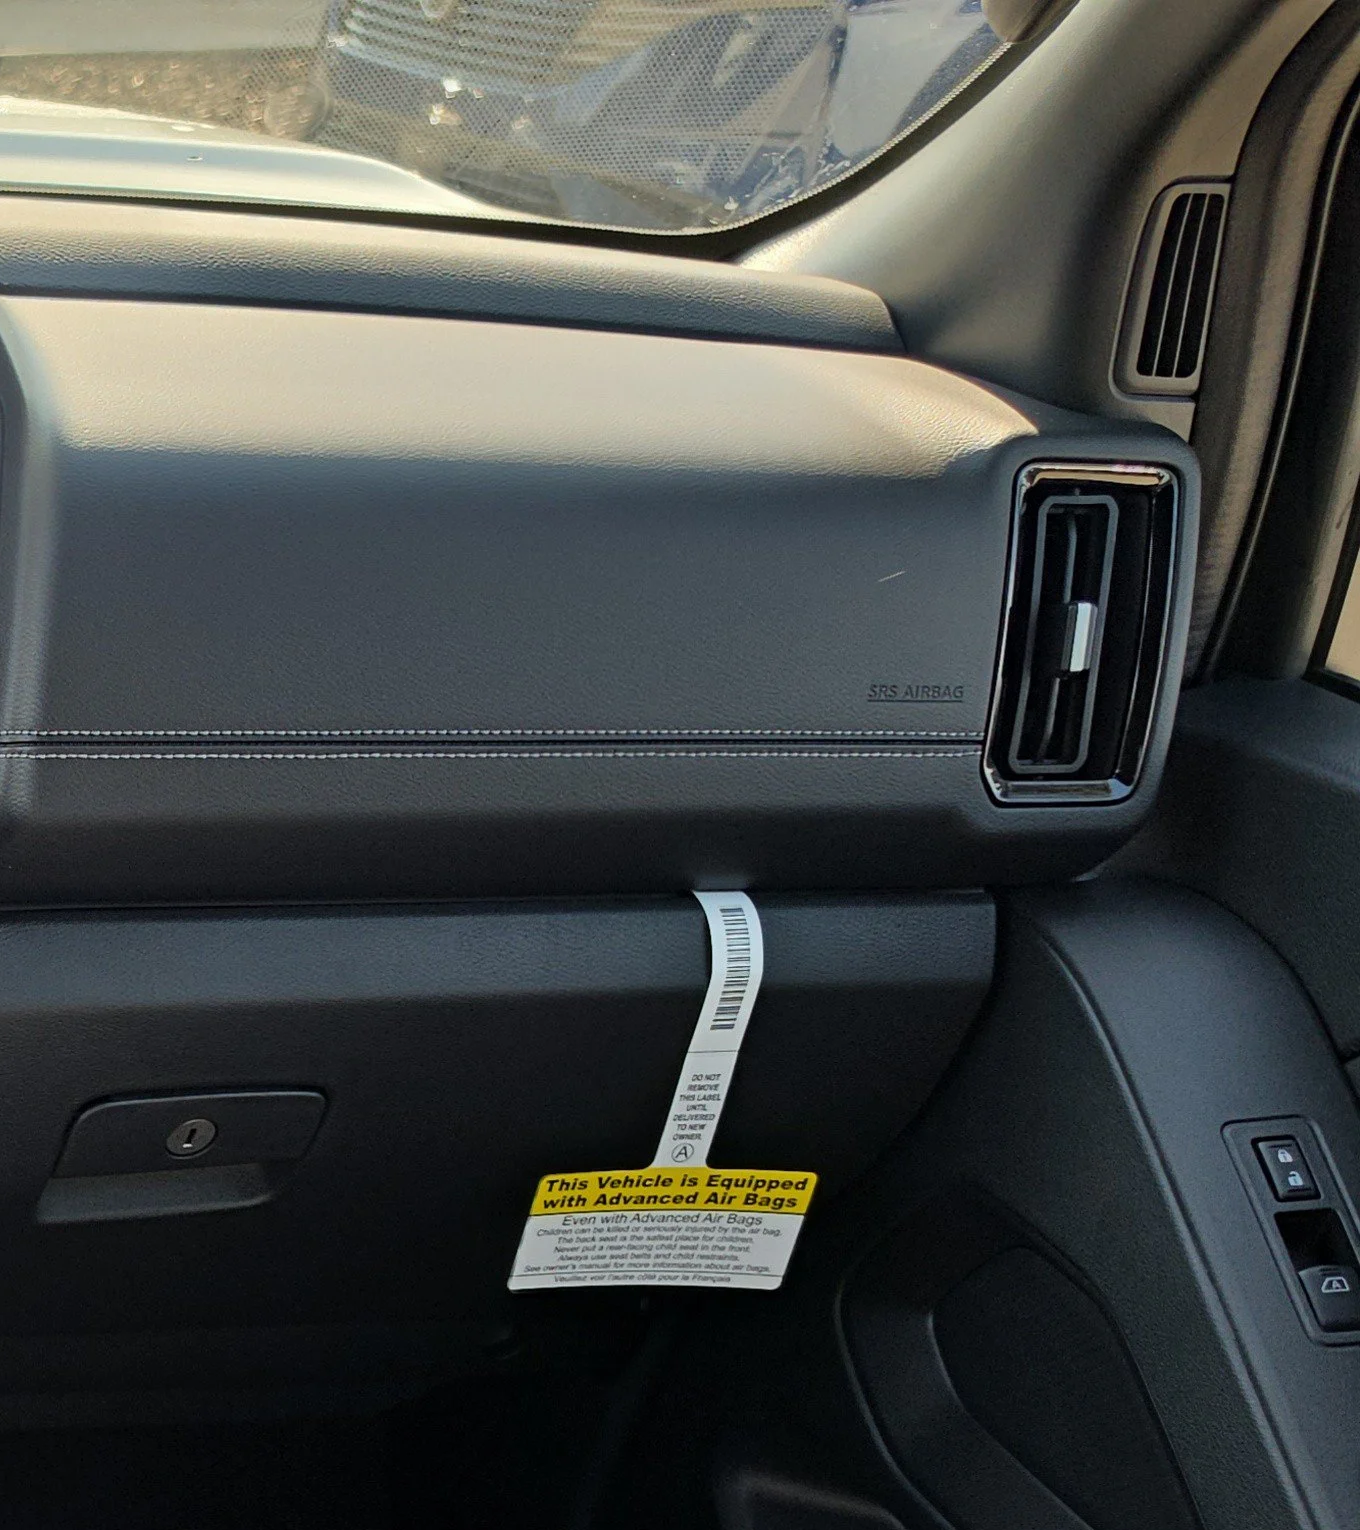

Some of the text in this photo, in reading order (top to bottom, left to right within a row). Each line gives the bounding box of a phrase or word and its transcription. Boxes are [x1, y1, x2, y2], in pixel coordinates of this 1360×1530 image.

[546, 1174, 809, 1192] This Vehicle is Equipped
[543, 1191, 799, 1210] with Advanced Air Bags
[562, 1213, 764, 1227] Even with Advanced Air Bags
